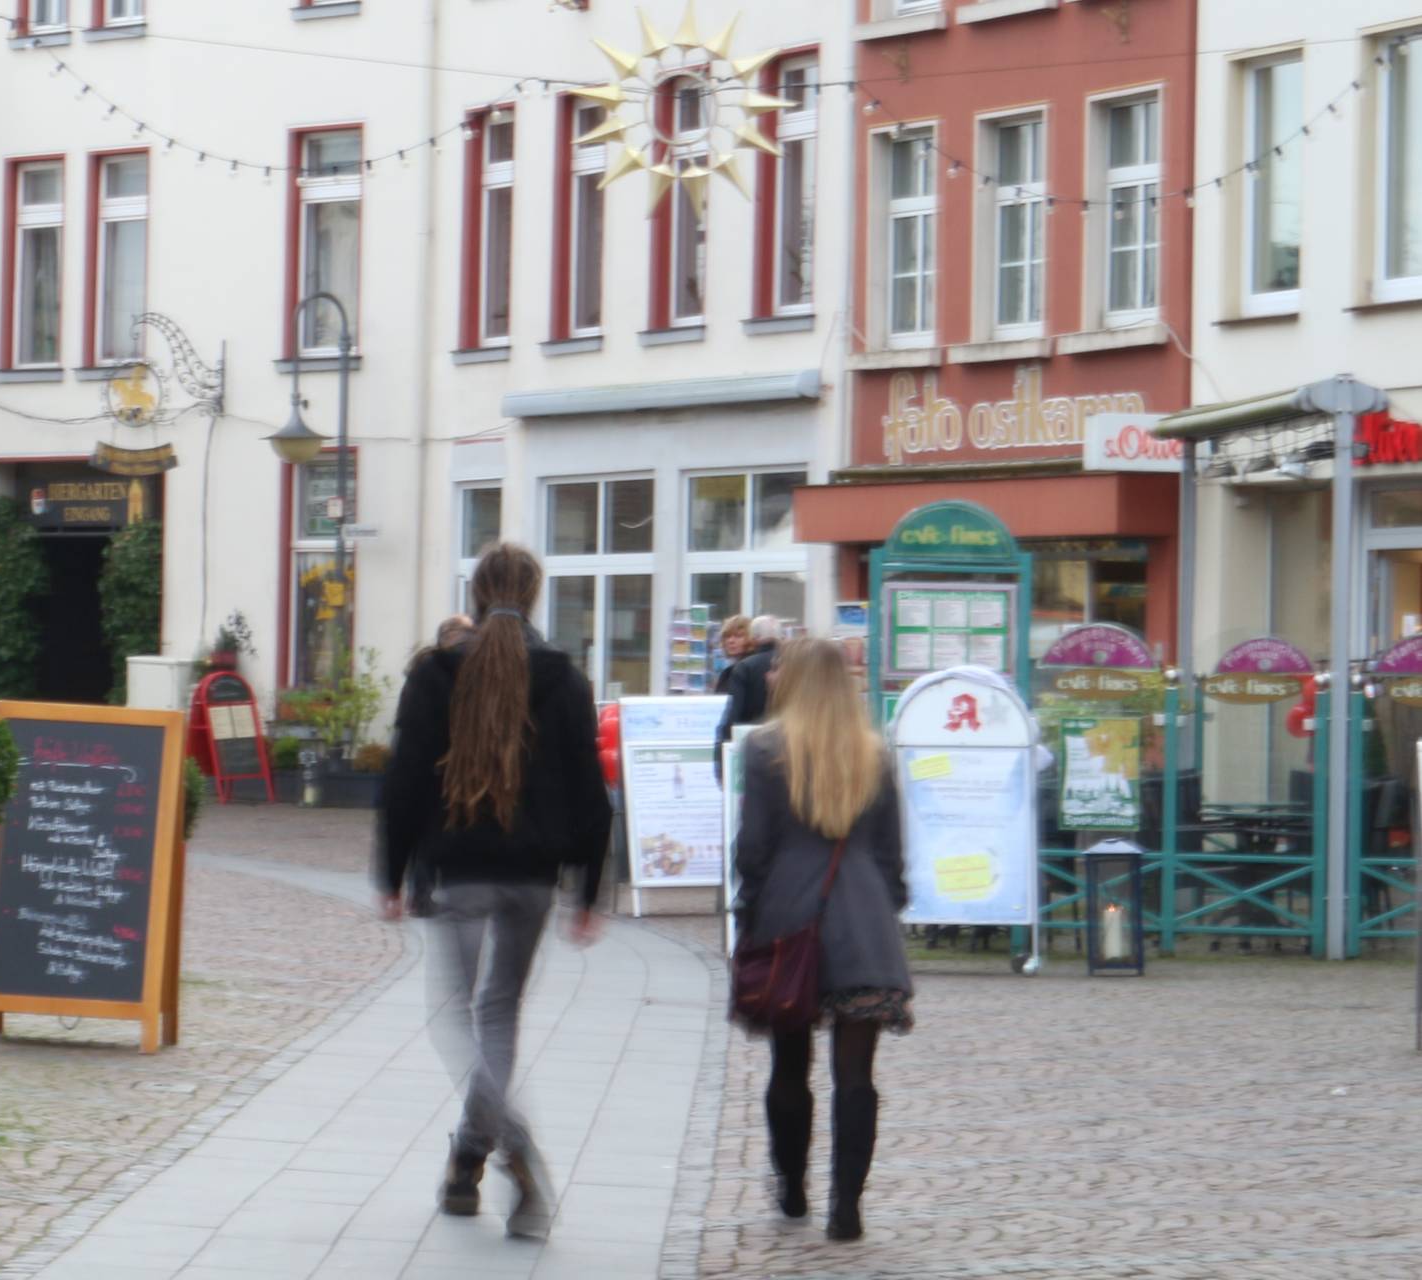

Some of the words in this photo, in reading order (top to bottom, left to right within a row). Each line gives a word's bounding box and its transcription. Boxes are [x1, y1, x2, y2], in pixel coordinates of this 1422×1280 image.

[881, 371, 963, 466] foto
[1104, 424, 1185, 461] s.Olive
[48, 482, 129, 501] BIERGARTEN
[63, 507, 112, 523] EINGANG
